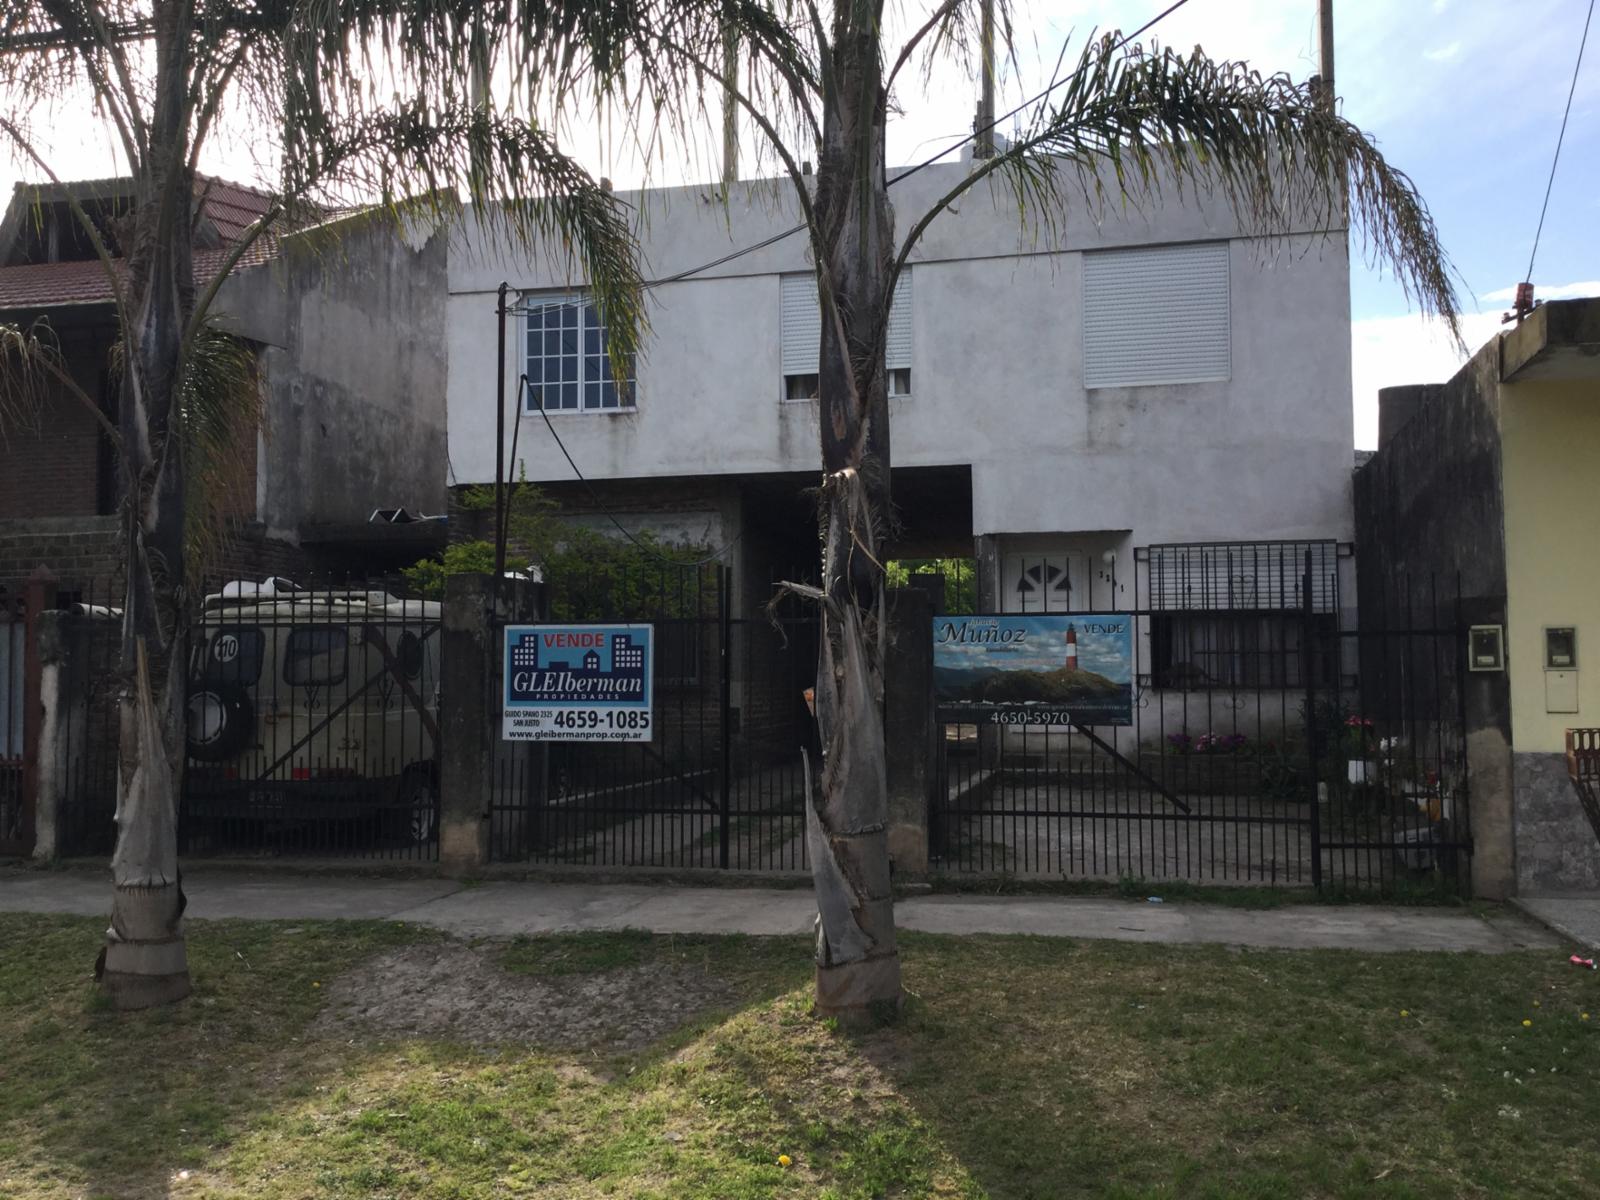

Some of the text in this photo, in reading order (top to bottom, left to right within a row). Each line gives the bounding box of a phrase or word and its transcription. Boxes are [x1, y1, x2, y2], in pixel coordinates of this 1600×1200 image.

[937, 622, 1026, 644] Muñoz
[1083, 623, 1125, 634] VENDE
[543, 633, 604, 648] VENDE
[217, 640, 237, 657] 110
[513, 671, 642, 693] GLEIberman
[504, 710, 522, 718] GUIDO
[522, 710, 540, 718] SPANO
[554, 710, 650, 729] 4659-1085
[990, 711, 1070, 725] 4650-5970
[513, 719, 540, 727] SAN JUSTO
[509, 730, 643, 740] www.gleibermanprop.com.ar
